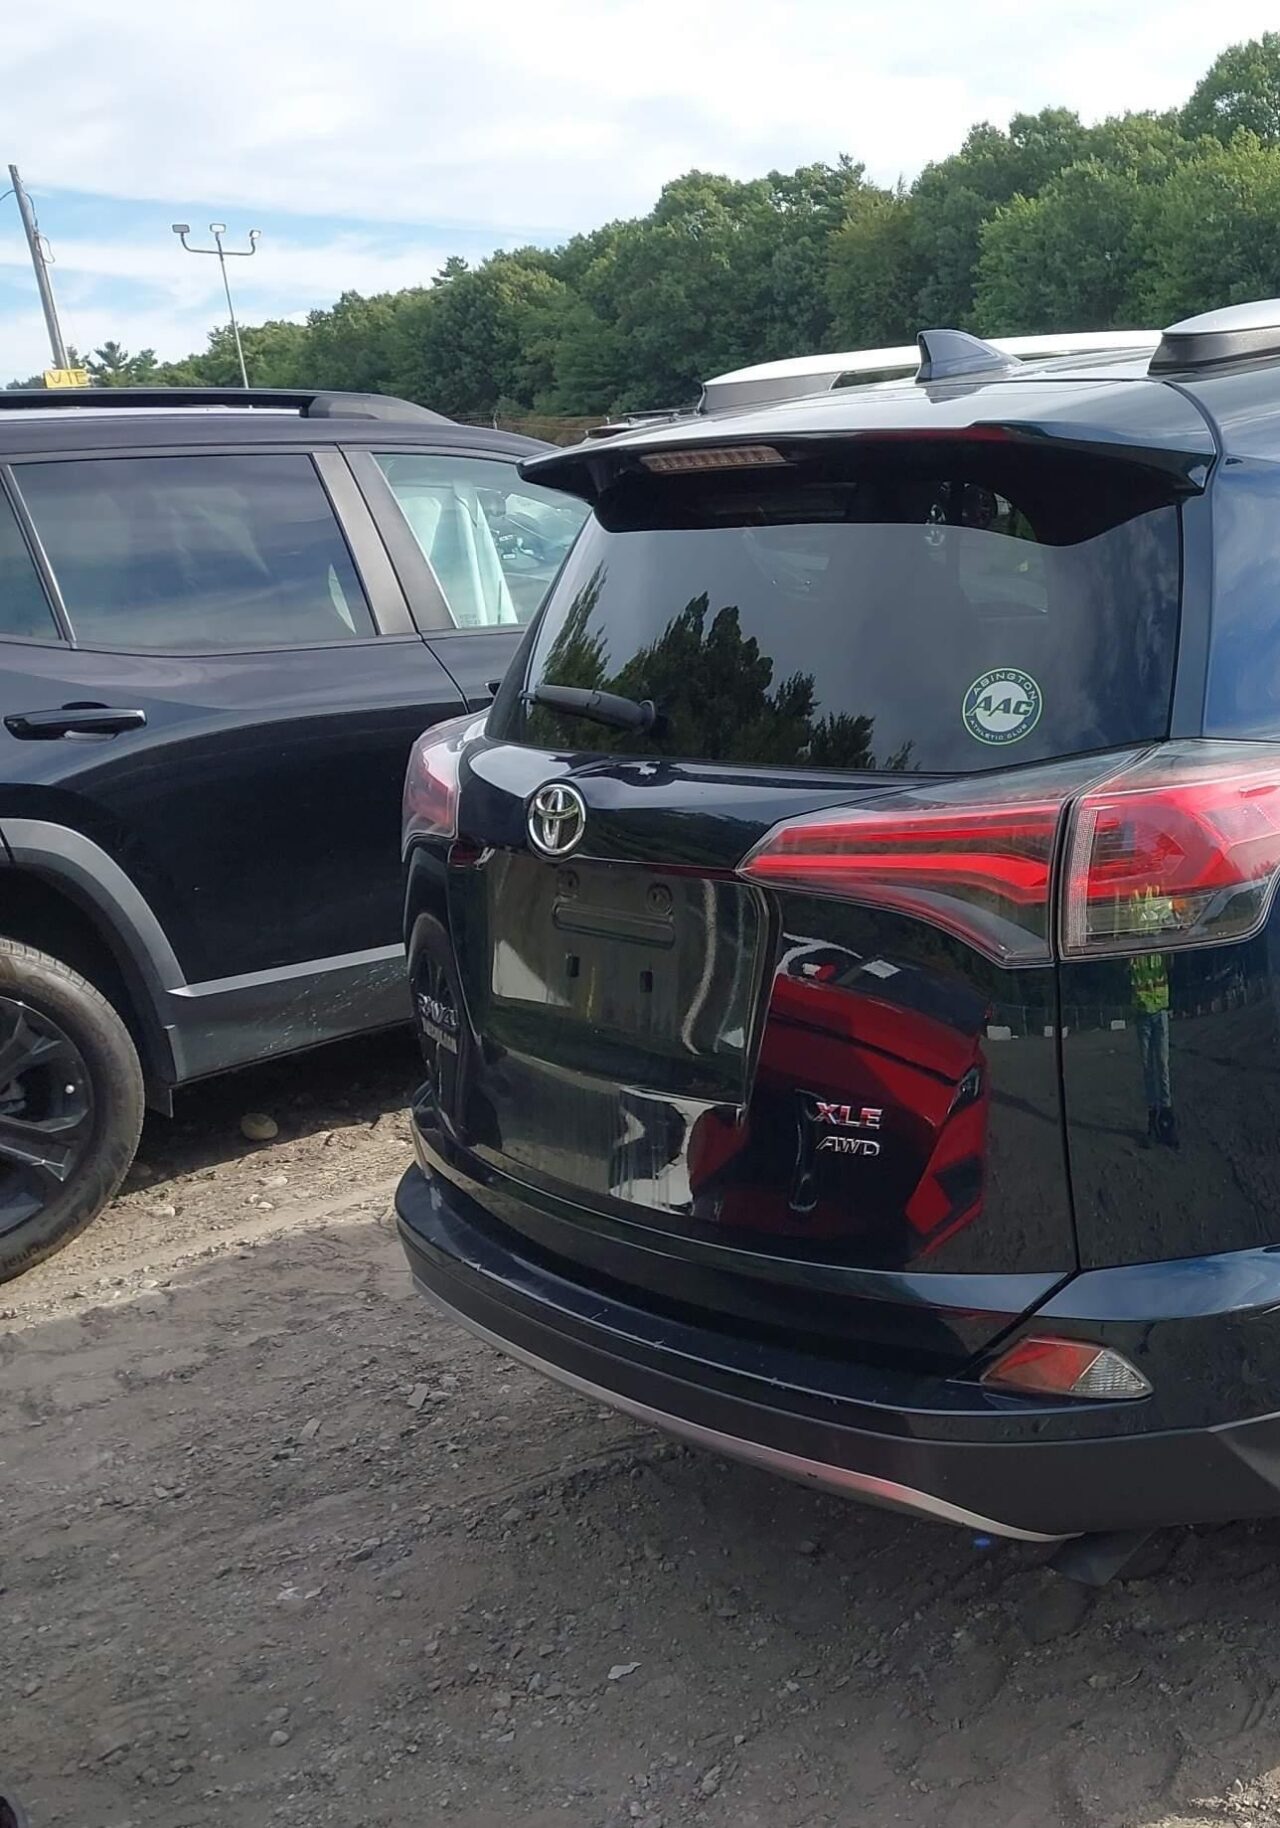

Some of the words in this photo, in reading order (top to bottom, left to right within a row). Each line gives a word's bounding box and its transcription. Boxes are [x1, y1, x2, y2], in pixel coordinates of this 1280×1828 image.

[973, 672, 1038, 700] ABINGTON
[966, 695, 1034, 717] AAC
[969, 720, 1005, 741] ATHLETIC
[1006, 723, 1028, 740] CLUB
[813, 1101, 884, 1129] XLE
[815, 1135, 881, 1157] AWD
